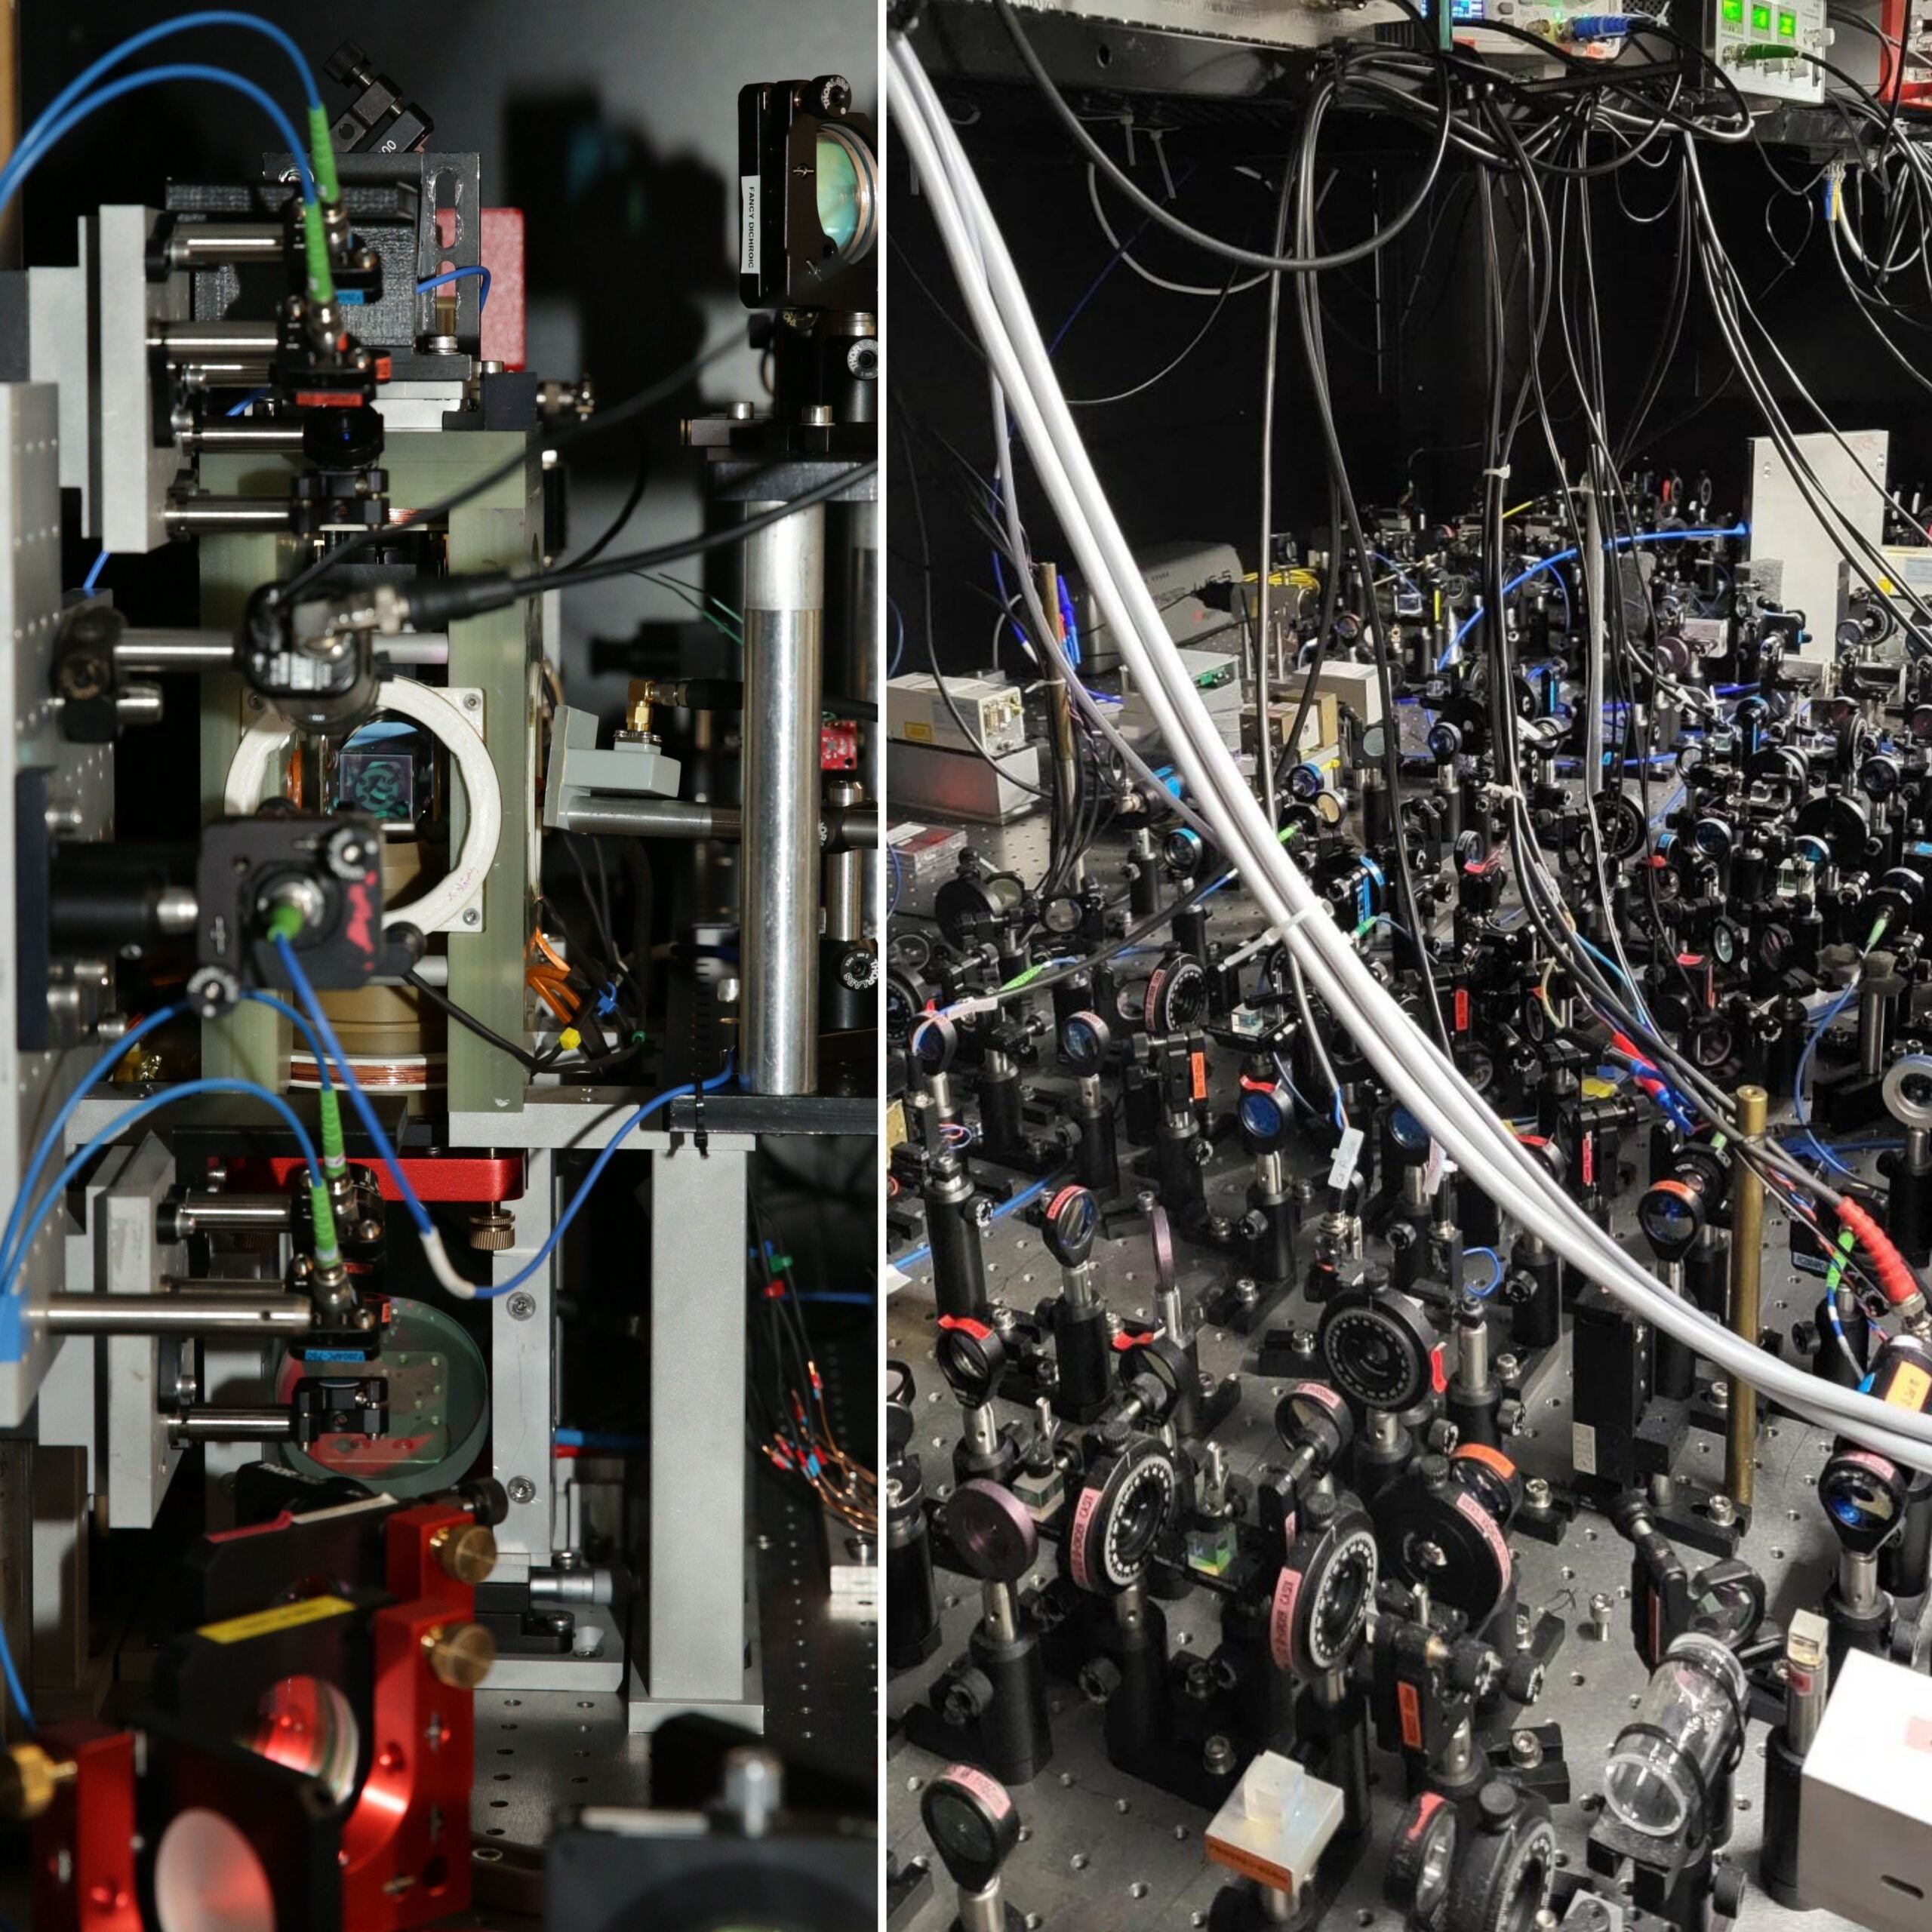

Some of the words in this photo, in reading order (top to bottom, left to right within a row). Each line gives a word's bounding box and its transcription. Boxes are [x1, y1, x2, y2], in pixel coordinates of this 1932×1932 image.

[823, 77, 849, 109] THORLABS
[378, 140, 397, 153] 00
[843, 958, 878, 989] THORLABS
